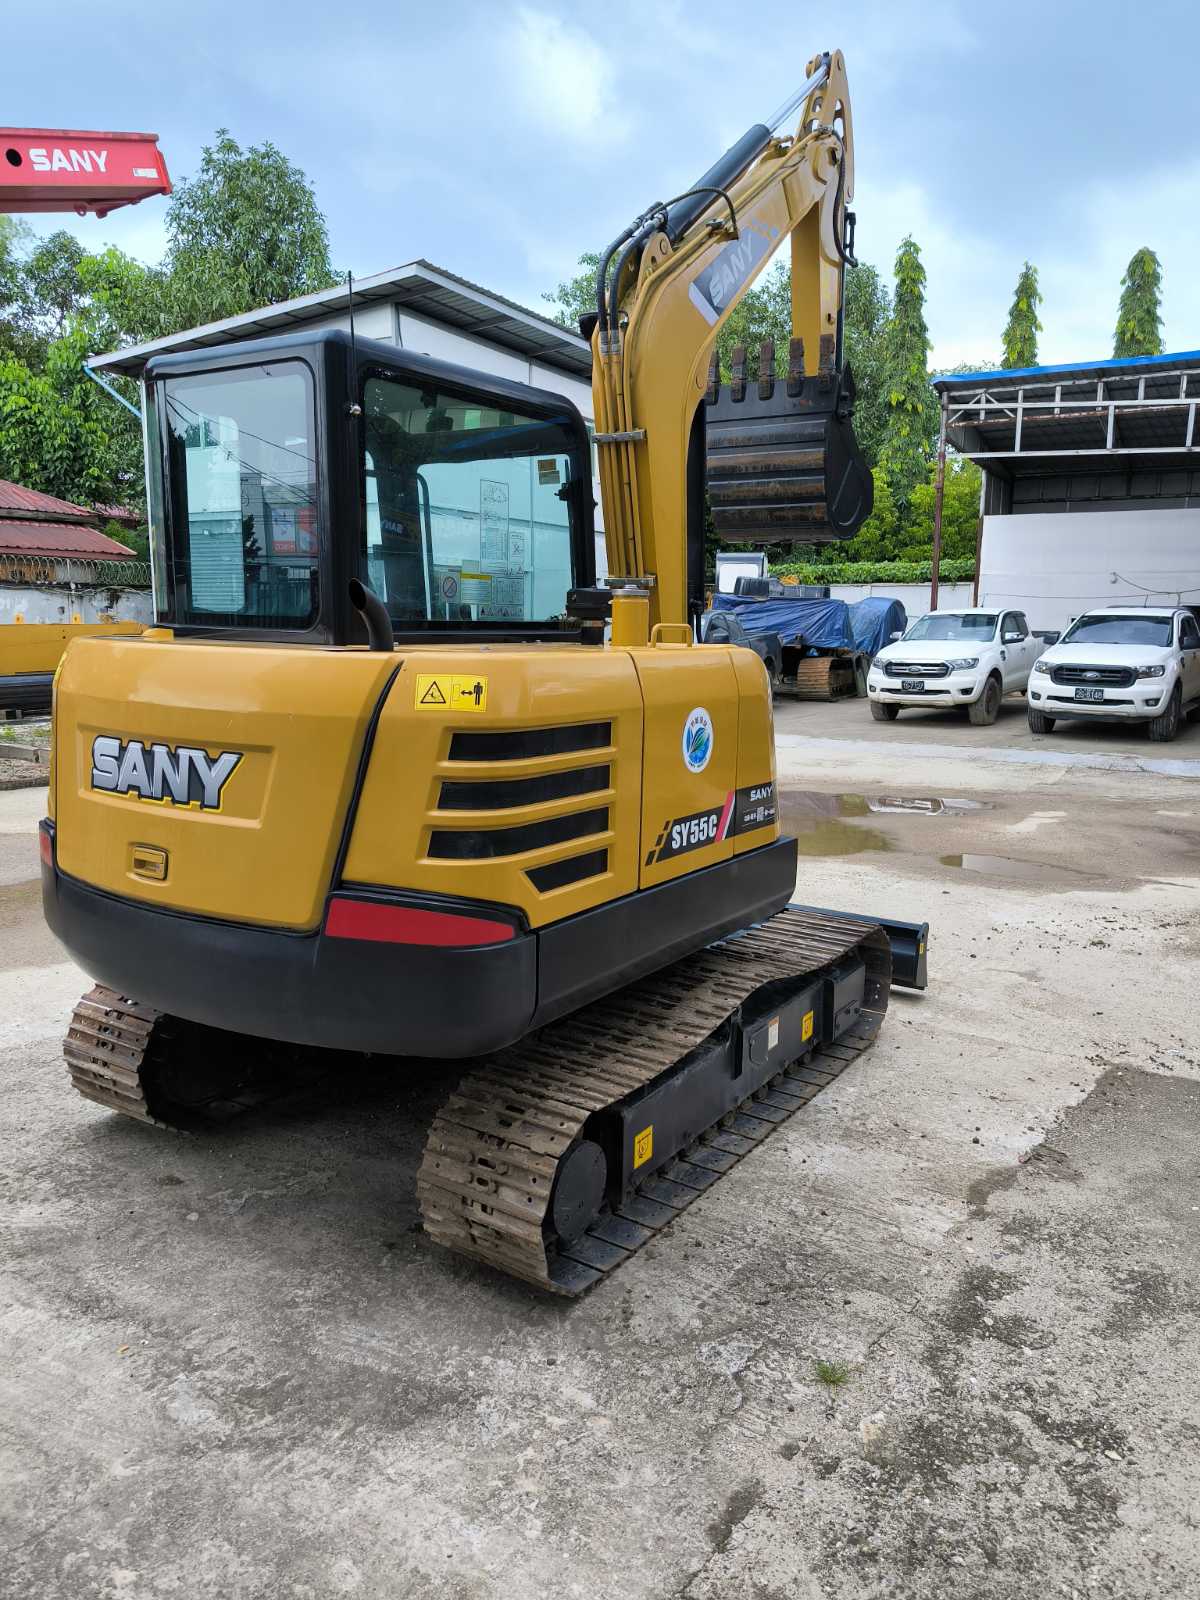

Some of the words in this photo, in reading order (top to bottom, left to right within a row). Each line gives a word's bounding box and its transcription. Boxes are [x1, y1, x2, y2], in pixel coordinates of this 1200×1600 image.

[28, 148, 108, 172] SANY
[709, 230, 753, 307] SANY
[92, 735, 243, 809] SANY
[671, 814, 718, 849] SY55C
